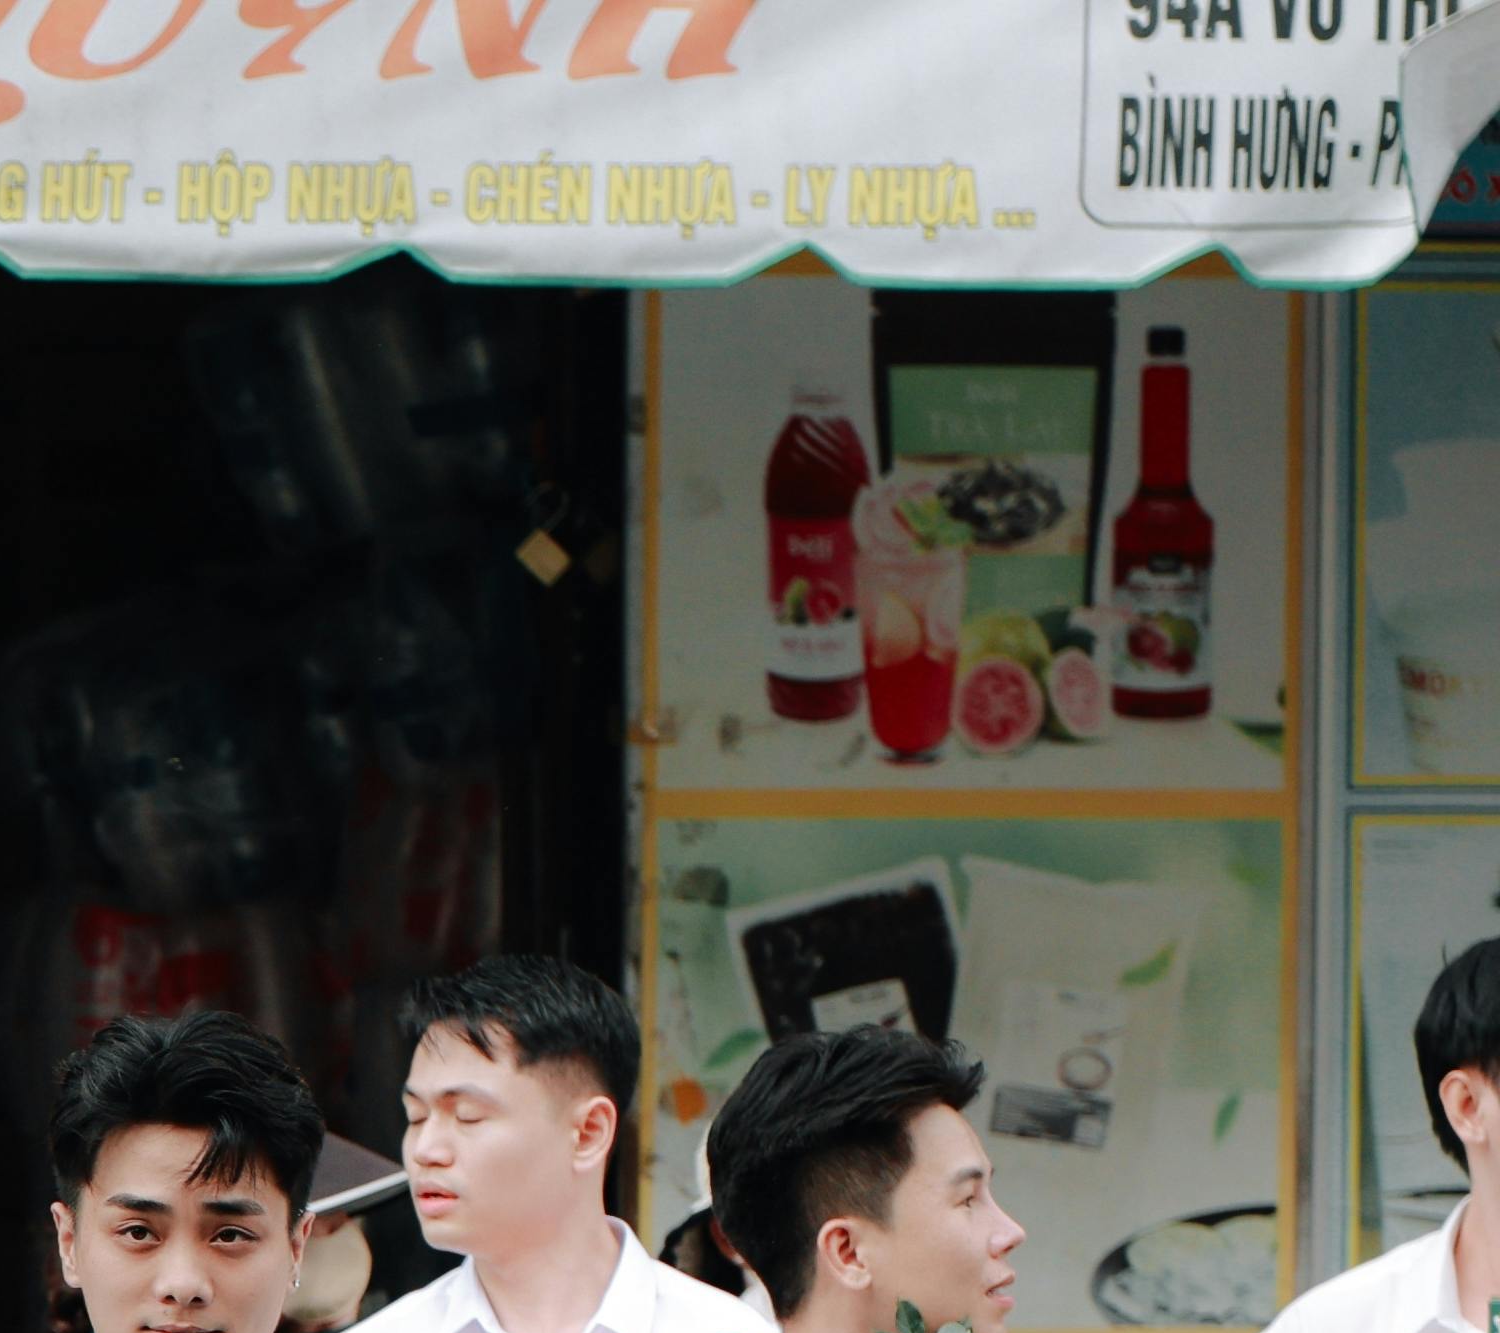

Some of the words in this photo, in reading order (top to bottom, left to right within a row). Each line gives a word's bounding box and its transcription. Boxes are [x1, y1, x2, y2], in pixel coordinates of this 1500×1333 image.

[1117, 71, 1214, 189] BÌNH
[40, 147, 132, 224] HÚT
[143, 187, 165, 205] -
[176, 149, 274, 237] HỘP
[286, 156, 416, 238] NHỰA
[429, 188, 451, 206] -
[462, 150, 593, 226] CHÉN
[605, 156, 738, 240] NHỰA
[783, 162, 837, 227] LY
[847, 161, 980, 241] NHỰA
